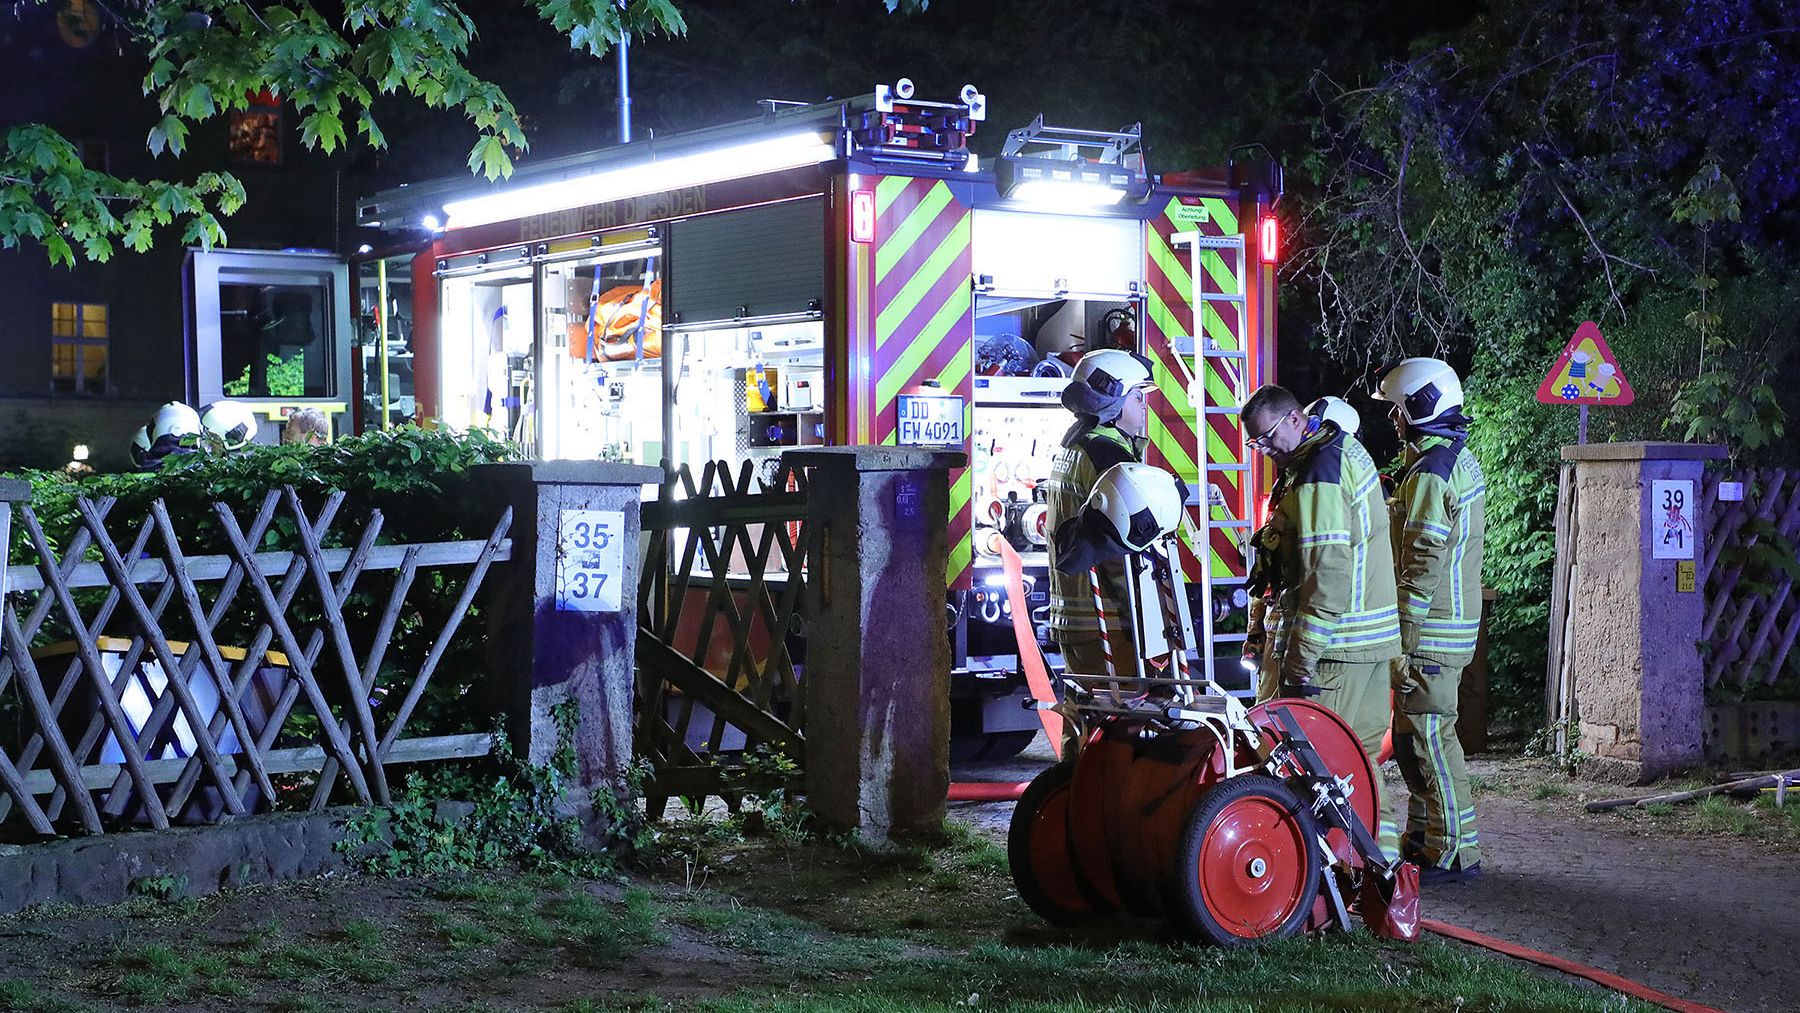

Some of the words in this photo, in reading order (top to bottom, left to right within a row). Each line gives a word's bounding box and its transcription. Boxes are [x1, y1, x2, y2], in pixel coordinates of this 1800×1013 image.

[520, 200, 617, 242] FEUERWEHR
[911, 401, 929, 419] DD
[903, 421, 921, 440] FW
[925, 421, 959, 440] 4091
[1662, 489, 1684, 510] 39
[573, 521, 609, 550] 35
[572, 572, 608, 599] 37
